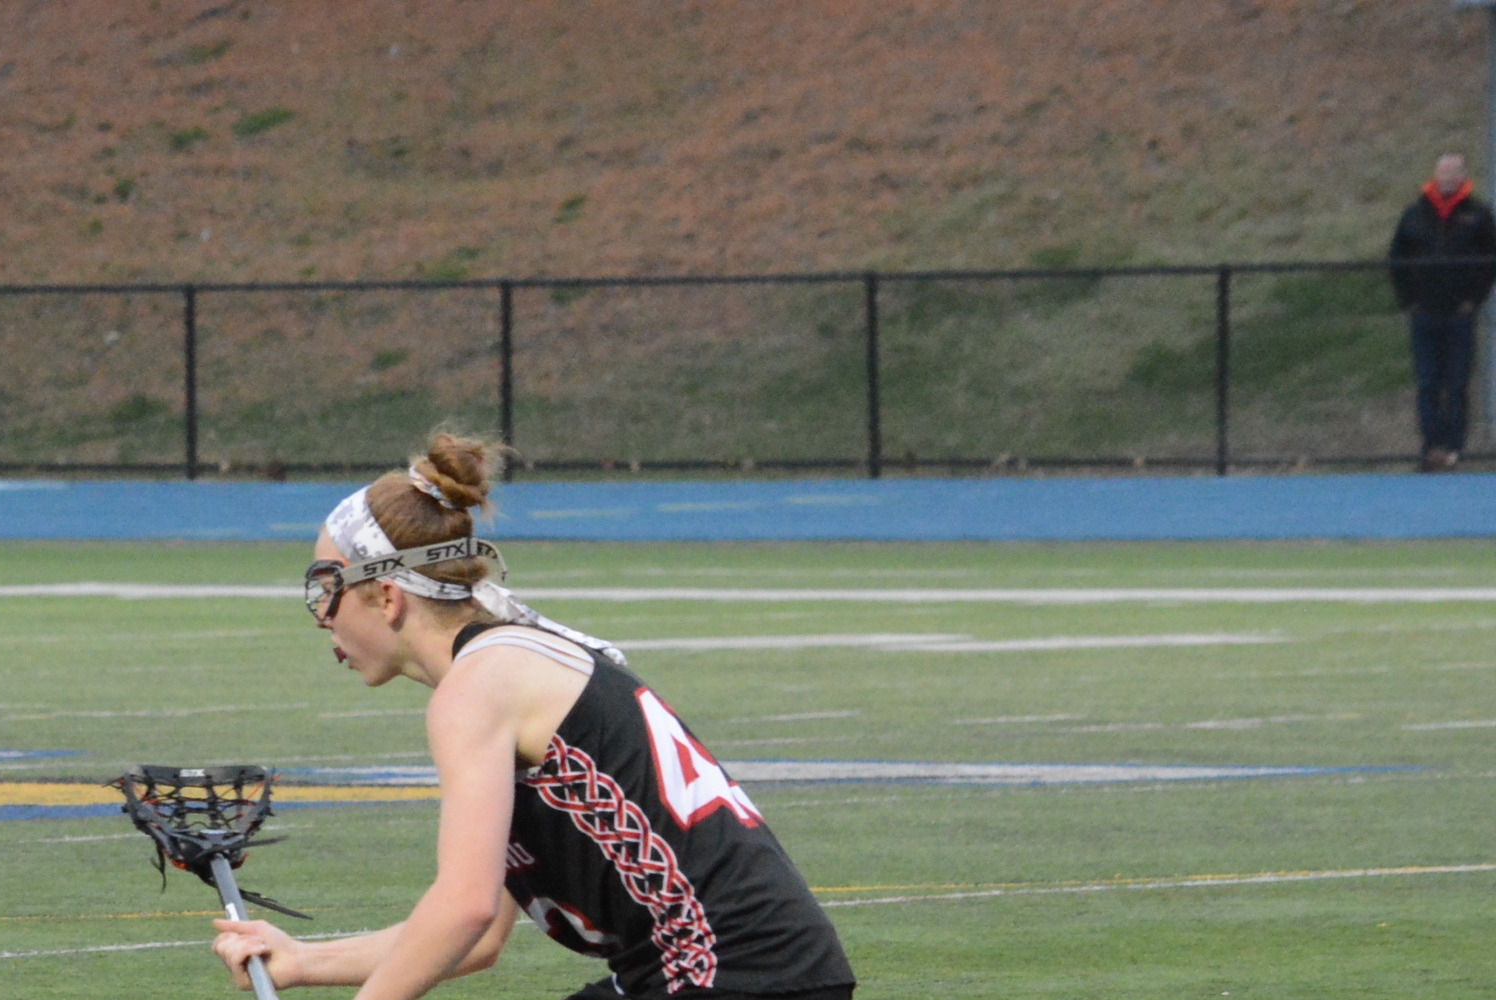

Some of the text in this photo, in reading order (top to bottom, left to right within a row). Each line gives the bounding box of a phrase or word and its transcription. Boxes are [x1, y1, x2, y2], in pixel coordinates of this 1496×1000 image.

[363, 556, 405, 576] STX
[426, 542, 465, 561] STX
[634, 686, 766, 832] 4
